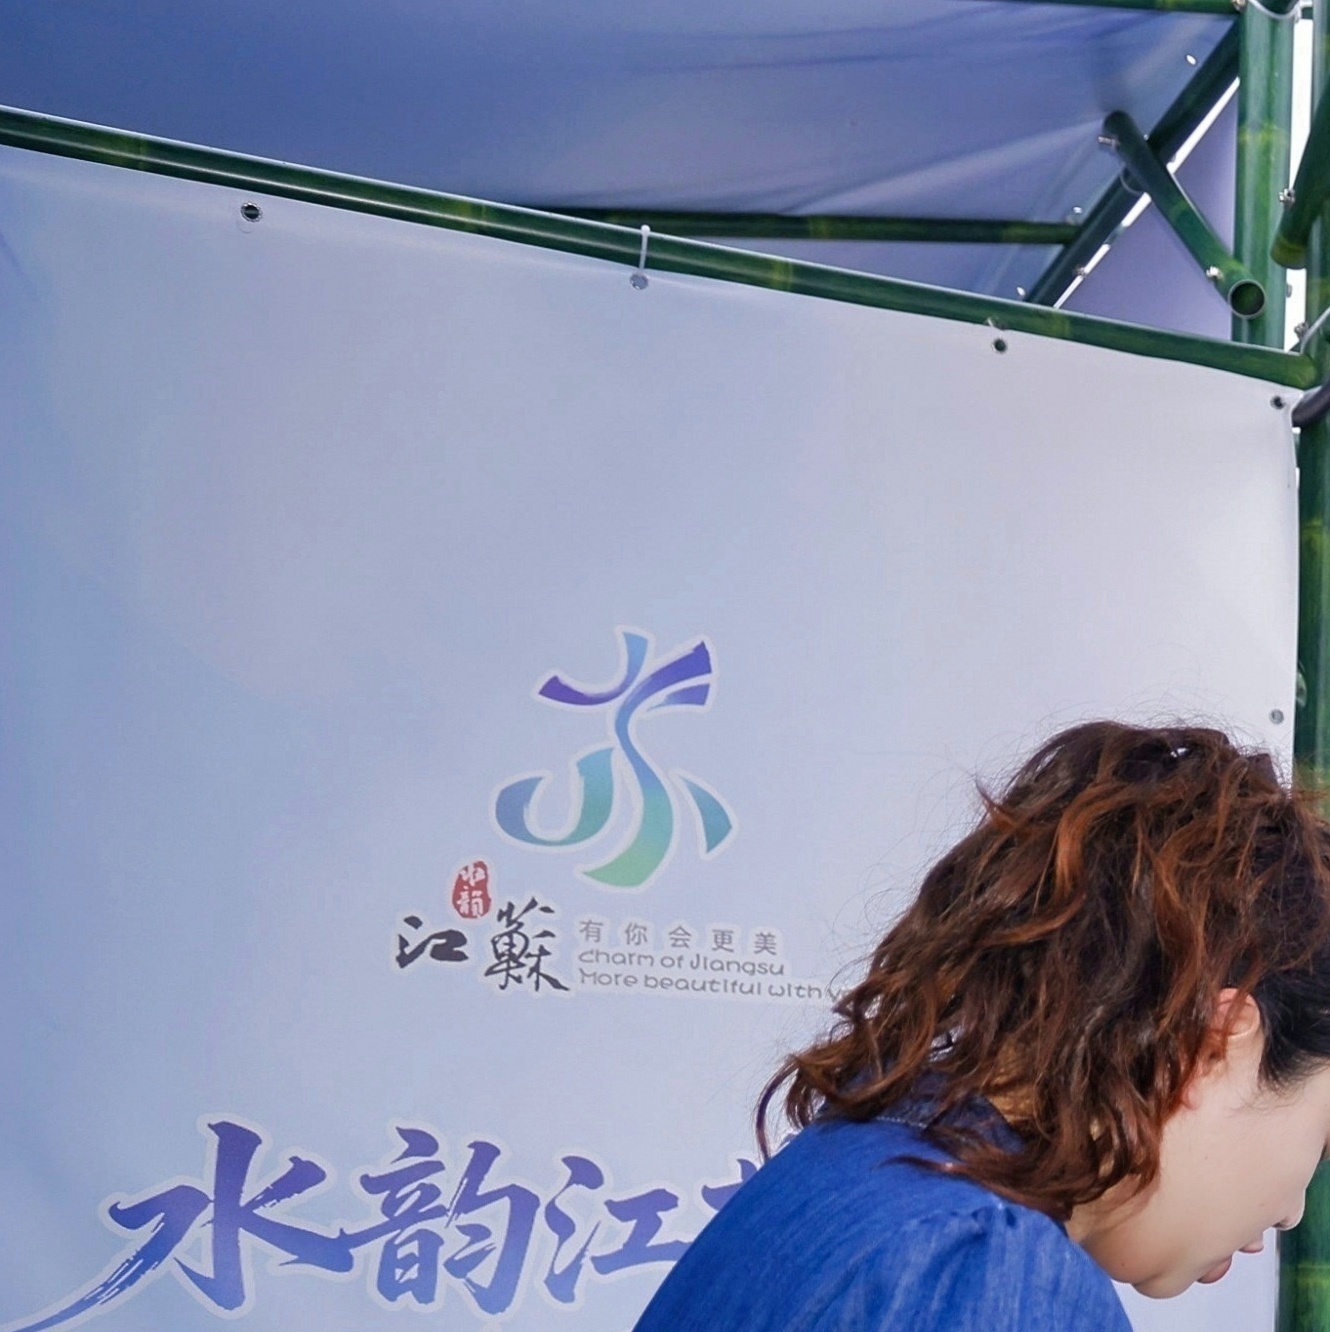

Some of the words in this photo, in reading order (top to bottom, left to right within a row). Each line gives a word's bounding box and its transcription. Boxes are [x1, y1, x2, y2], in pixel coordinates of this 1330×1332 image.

[578, 919, 778, 957] 有你会更美
[660, 954, 686, 970] of
[578, 967, 638, 987] More
[643, 973, 762, 995] beautiful
[768, 981, 823, 999] with
